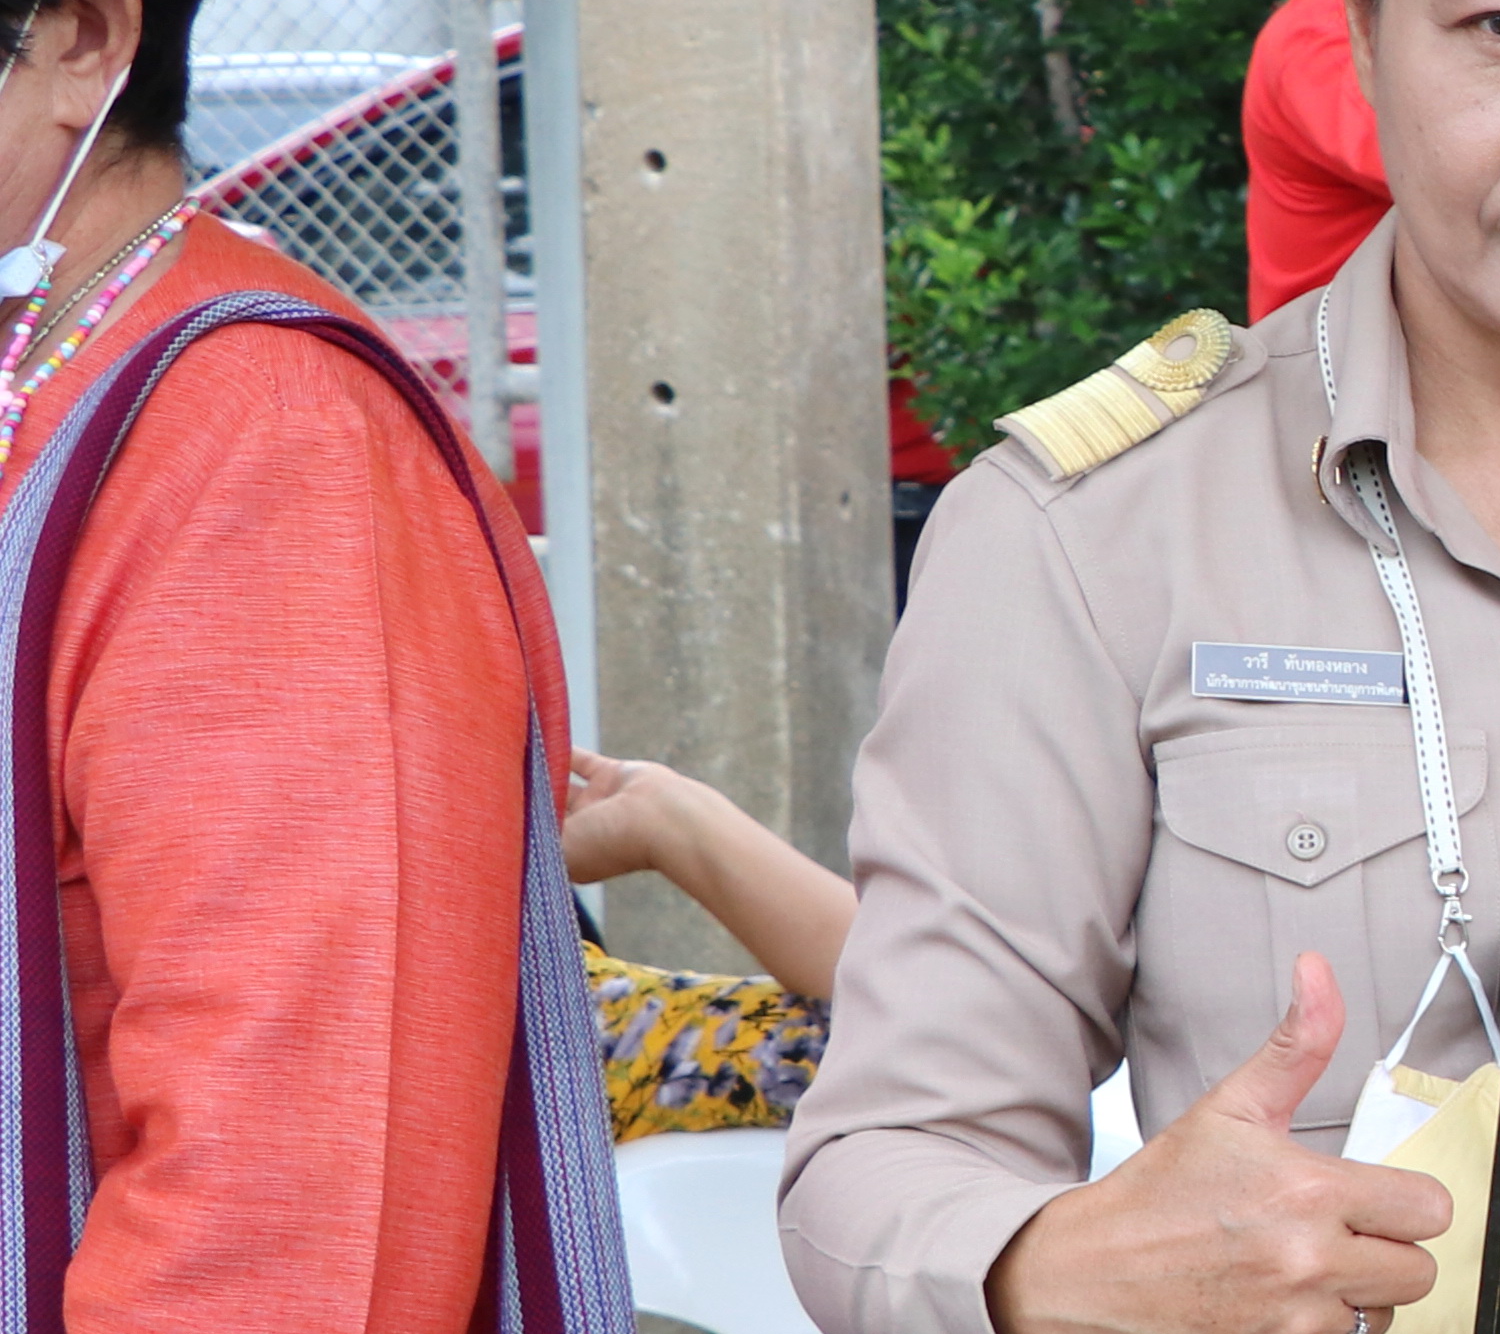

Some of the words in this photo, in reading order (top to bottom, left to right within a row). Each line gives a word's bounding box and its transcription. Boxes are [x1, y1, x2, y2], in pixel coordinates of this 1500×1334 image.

[1243, 652, 1270, 670] วารี
[1284, 653, 1368, 675] ทับทองหลาง
